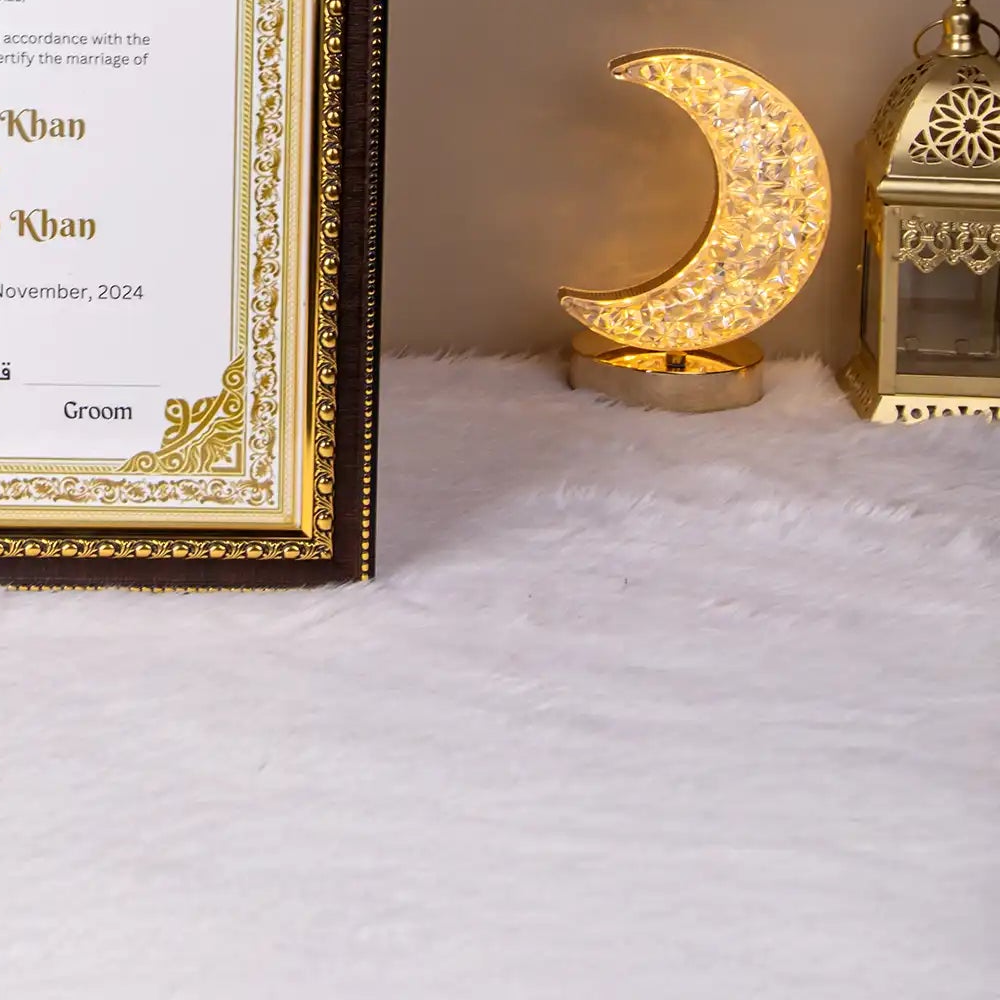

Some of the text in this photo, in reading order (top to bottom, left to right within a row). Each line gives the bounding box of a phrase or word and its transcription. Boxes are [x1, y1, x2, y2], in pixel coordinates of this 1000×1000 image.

[2, 31, 89, 46] accordance
[91, 32, 123, 46] with
[125, 32, 151, 46] the
[37, 51, 65, 65] the
[65, 52, 130, 69] marriage
[132, 52, 150, 66] of
[8, 207, 97, 244] Khan
[97, 283, 145, 301] 2024
[63, 400, 133, 421] Groom
